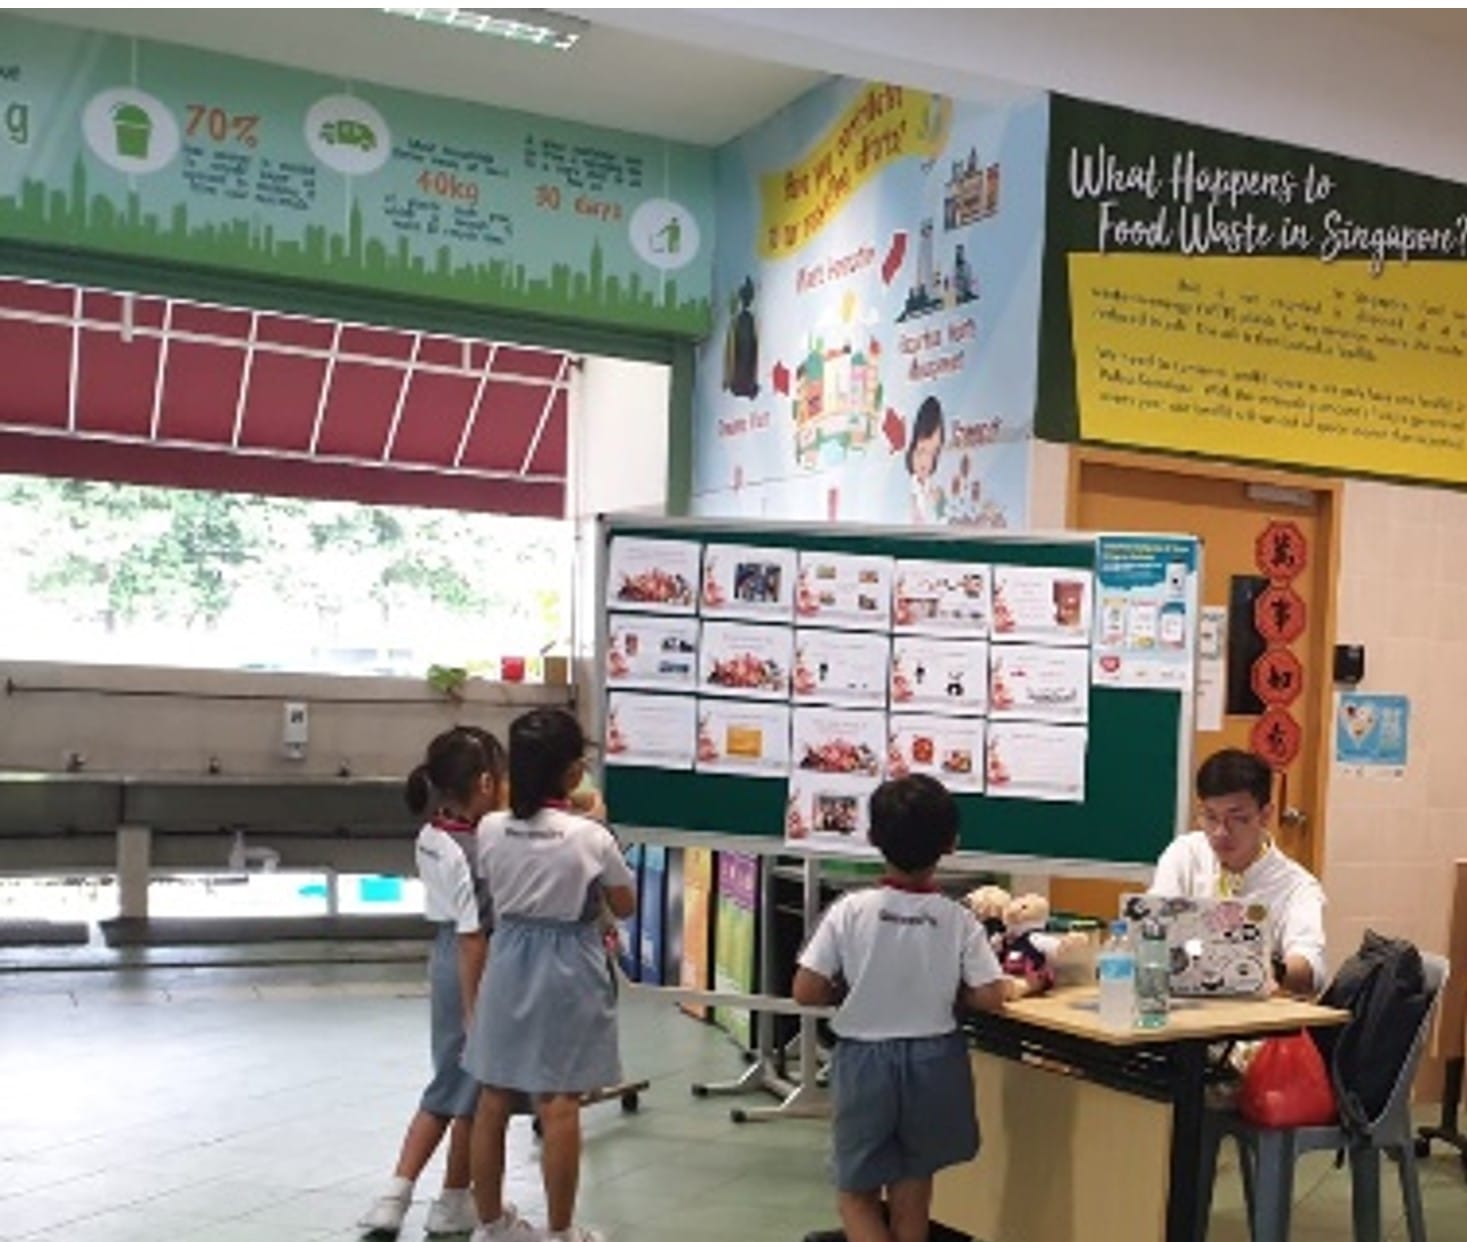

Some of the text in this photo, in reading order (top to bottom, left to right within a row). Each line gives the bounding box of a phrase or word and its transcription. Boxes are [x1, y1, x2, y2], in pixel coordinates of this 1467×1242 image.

[185, 104, 260, 148] 70%
[417, 169, 480, 206] 40kg
[1071, 145, 1336, 208] What Happens to
[1098, 200, 1173, 254] Food
[1180, 205, 1272, 254] Waste
[1281, 217, 1311, 251] in
